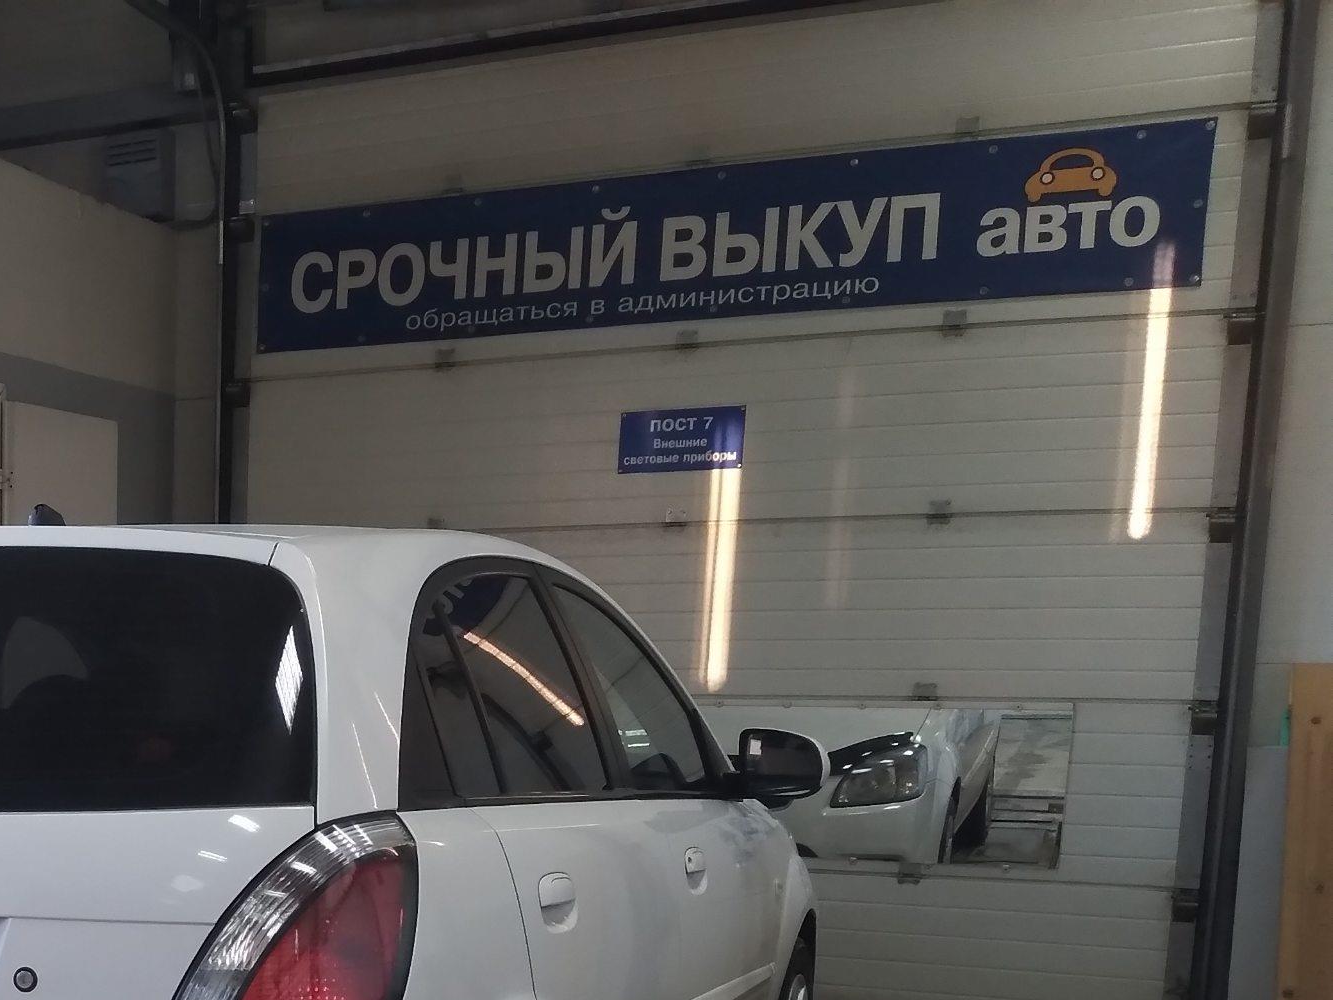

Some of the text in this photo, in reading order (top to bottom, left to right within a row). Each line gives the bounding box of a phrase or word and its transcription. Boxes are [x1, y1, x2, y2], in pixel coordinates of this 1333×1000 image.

[291, 192, 1162, 314] СРОЧНЫЙ ВЫКУП авто
[405, 276, 880, 332] обращаться в администрацию
[649, 416, 714, 433] ПОСТ 7
[653, 437, 708, 449] Внешние
[623, 450, 738, 466] световые приборы
